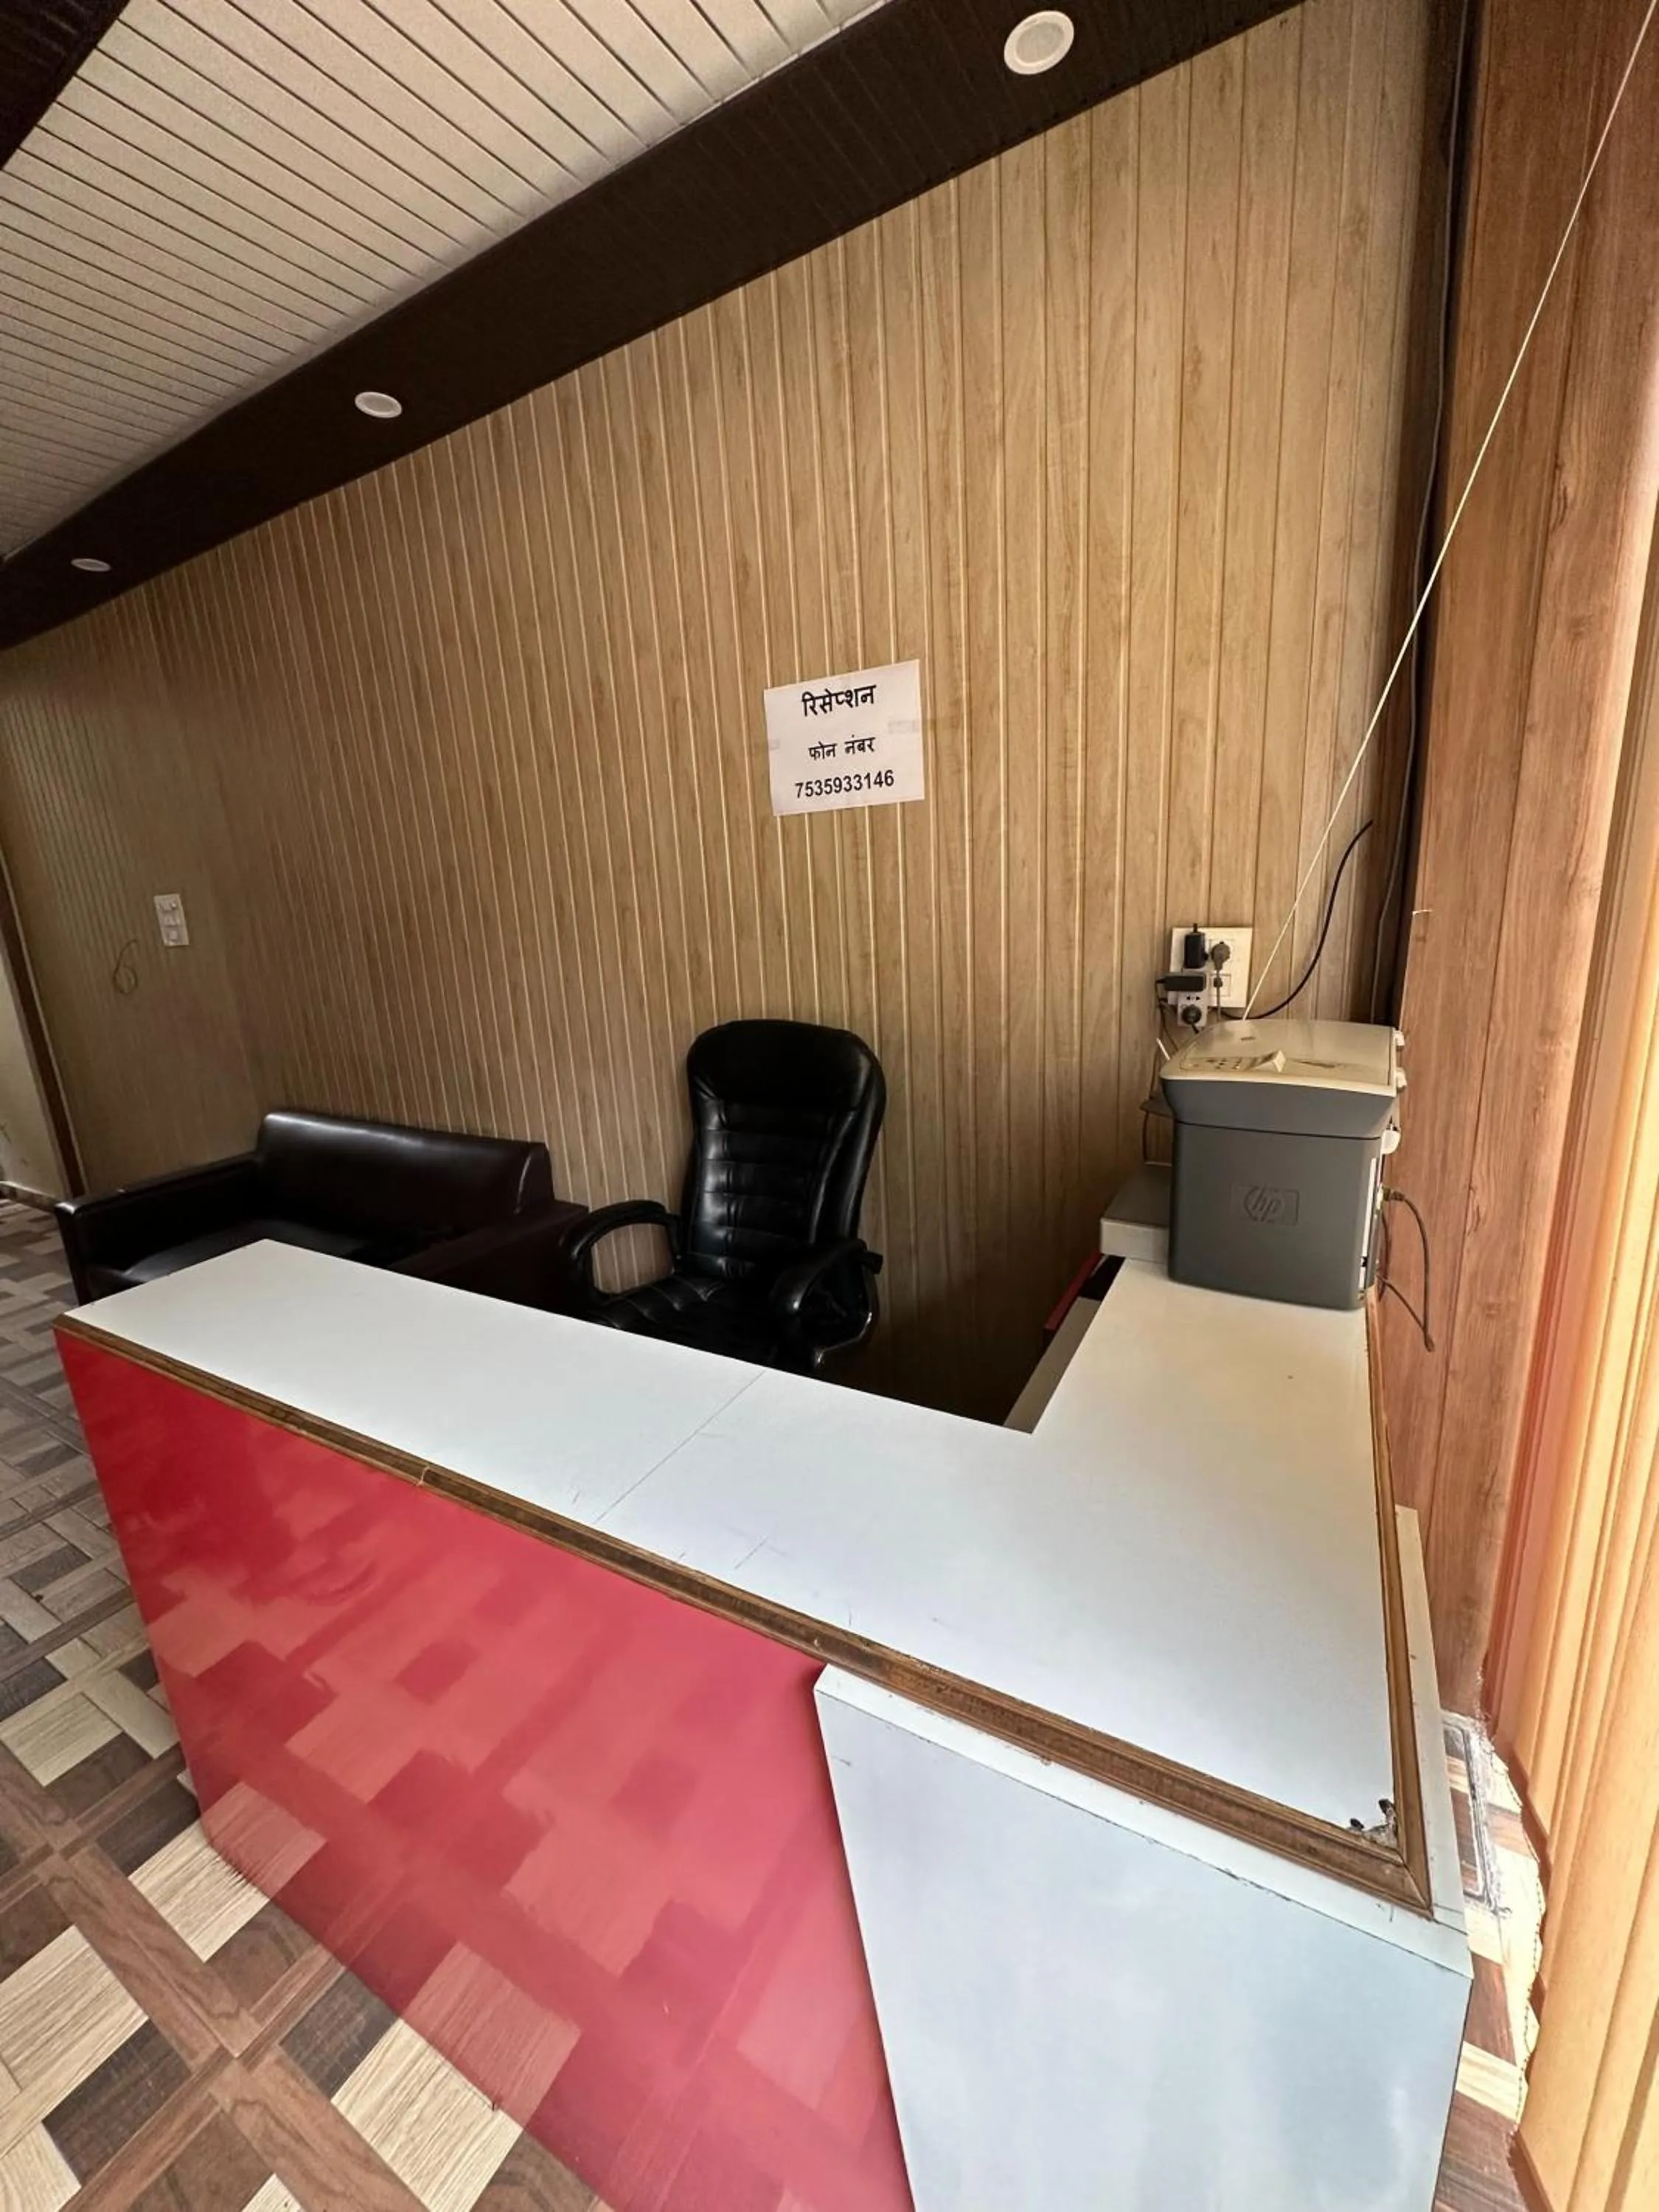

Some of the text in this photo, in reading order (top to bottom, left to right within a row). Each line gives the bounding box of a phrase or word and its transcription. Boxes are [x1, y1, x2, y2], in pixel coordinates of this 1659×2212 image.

[801, 684, 877, 717] रिसेप्शन
[808, 734, 876, 760] फोन नंबर
[795, 769, 895, 799] 7535933146
[1249, 1182, 1283, 1223] hp
